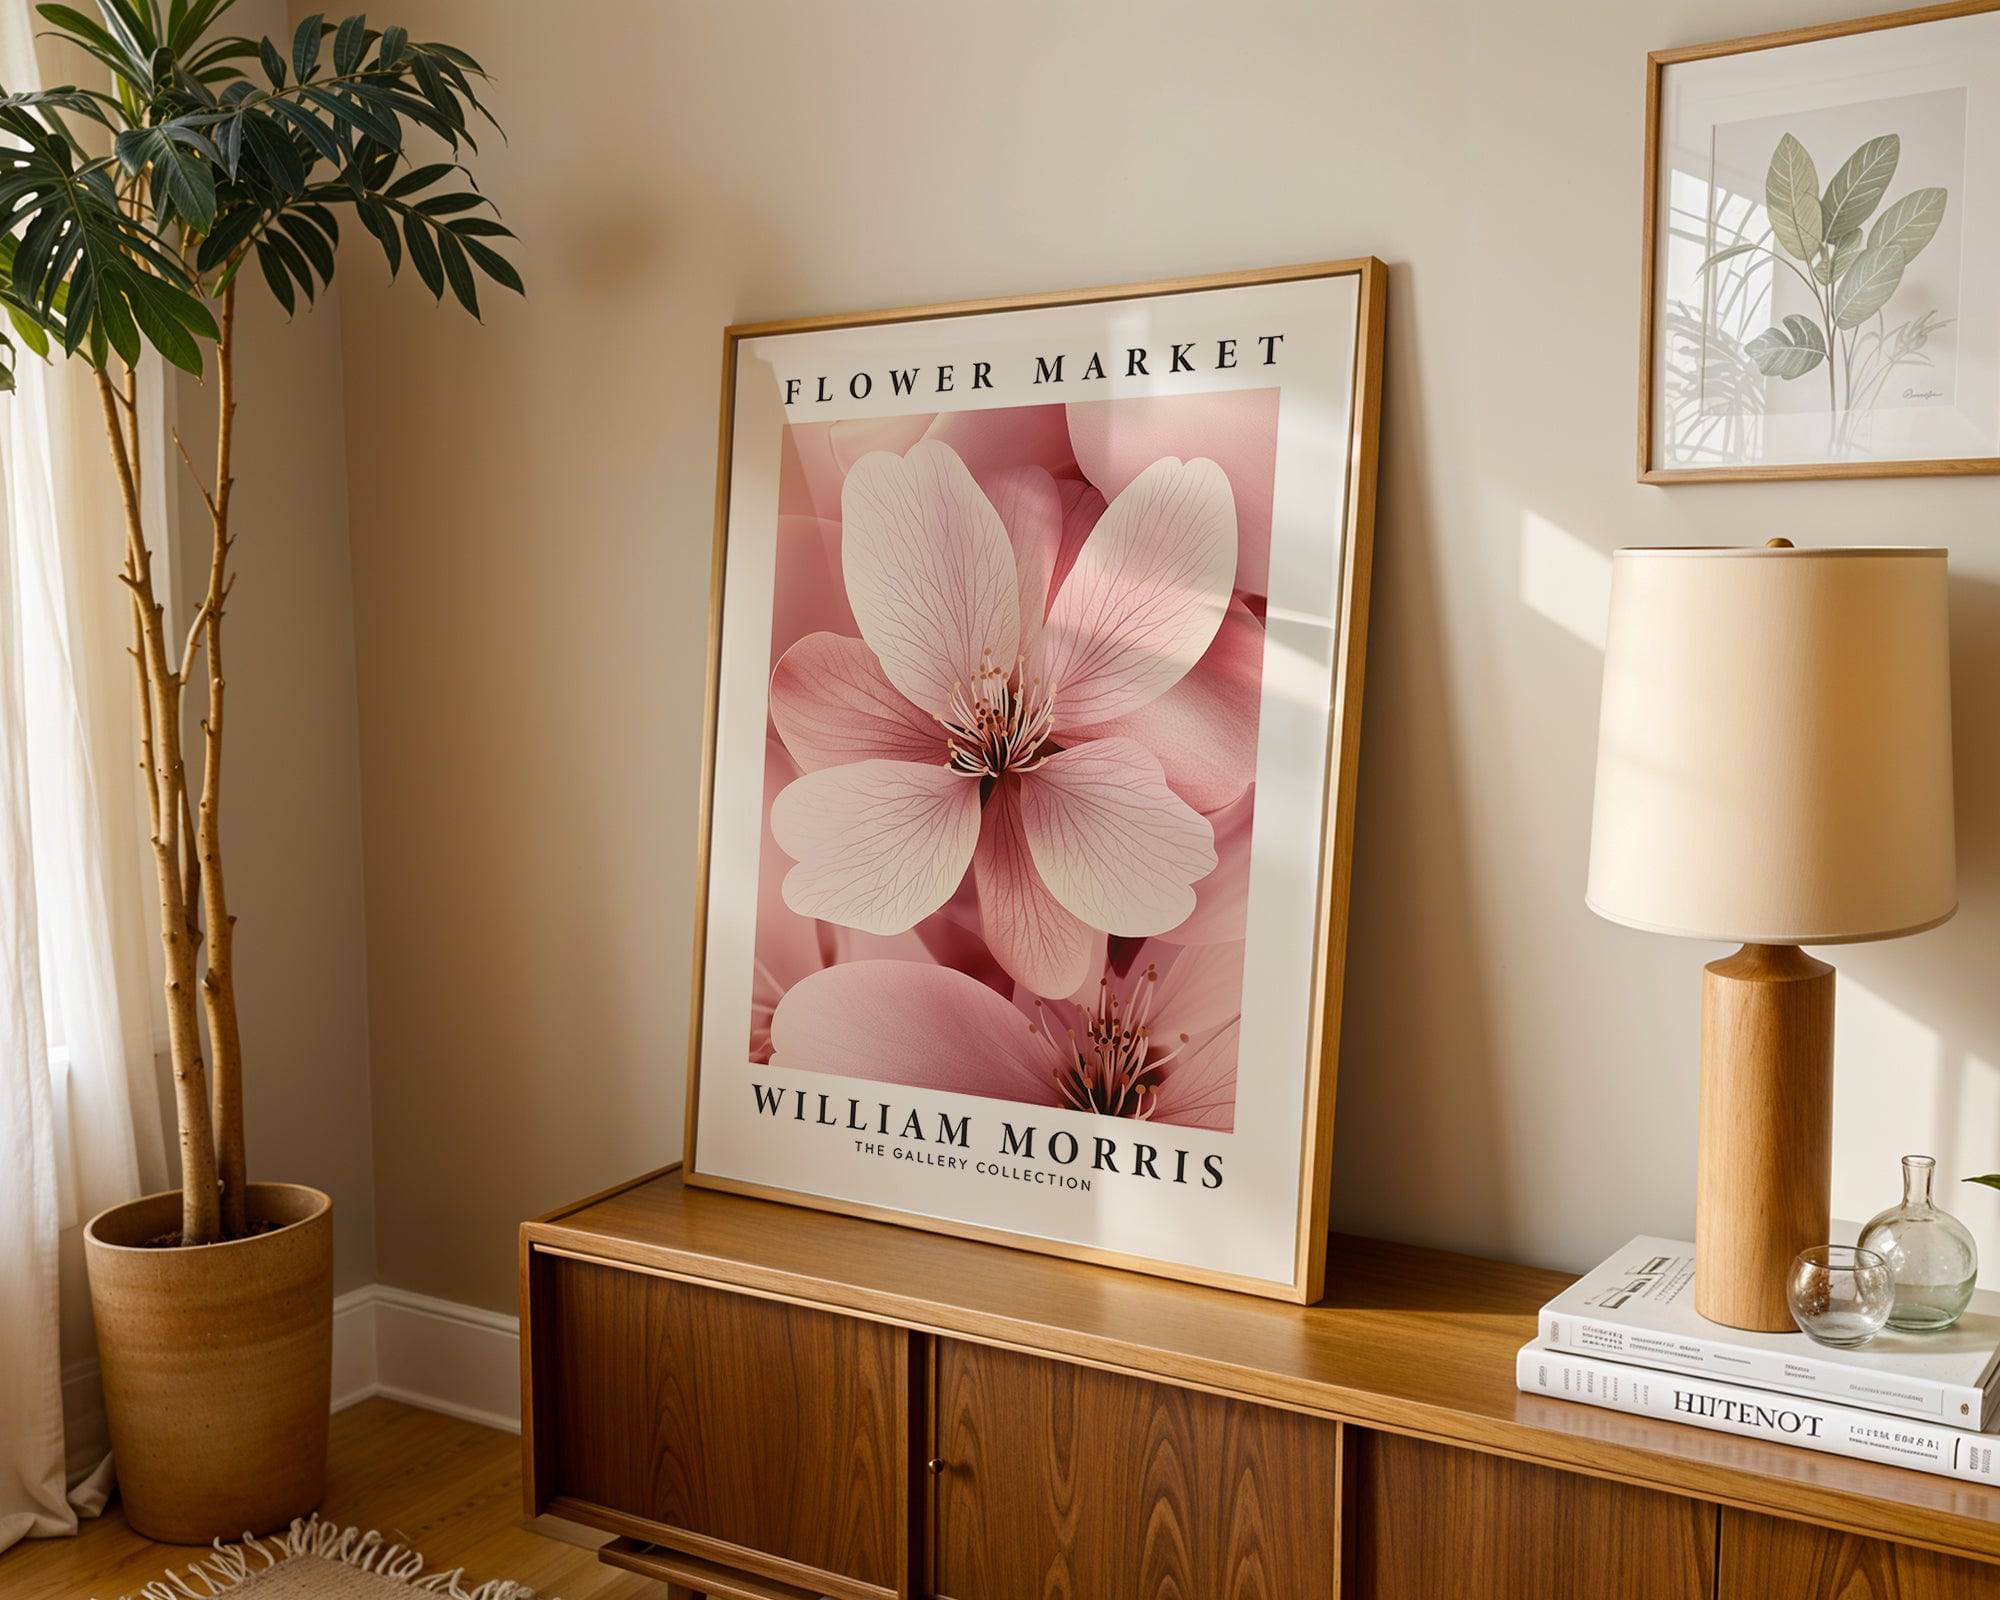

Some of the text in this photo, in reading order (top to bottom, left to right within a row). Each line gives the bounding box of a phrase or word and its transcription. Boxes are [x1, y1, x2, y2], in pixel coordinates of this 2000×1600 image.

[784, 334, 1284, 405] FLOWER MARKET
[751, 1083, 1224, 1190] WILLIAM MORRIS
[854, 1140, 1092, 1192] THE GALLERY COLLECTION
